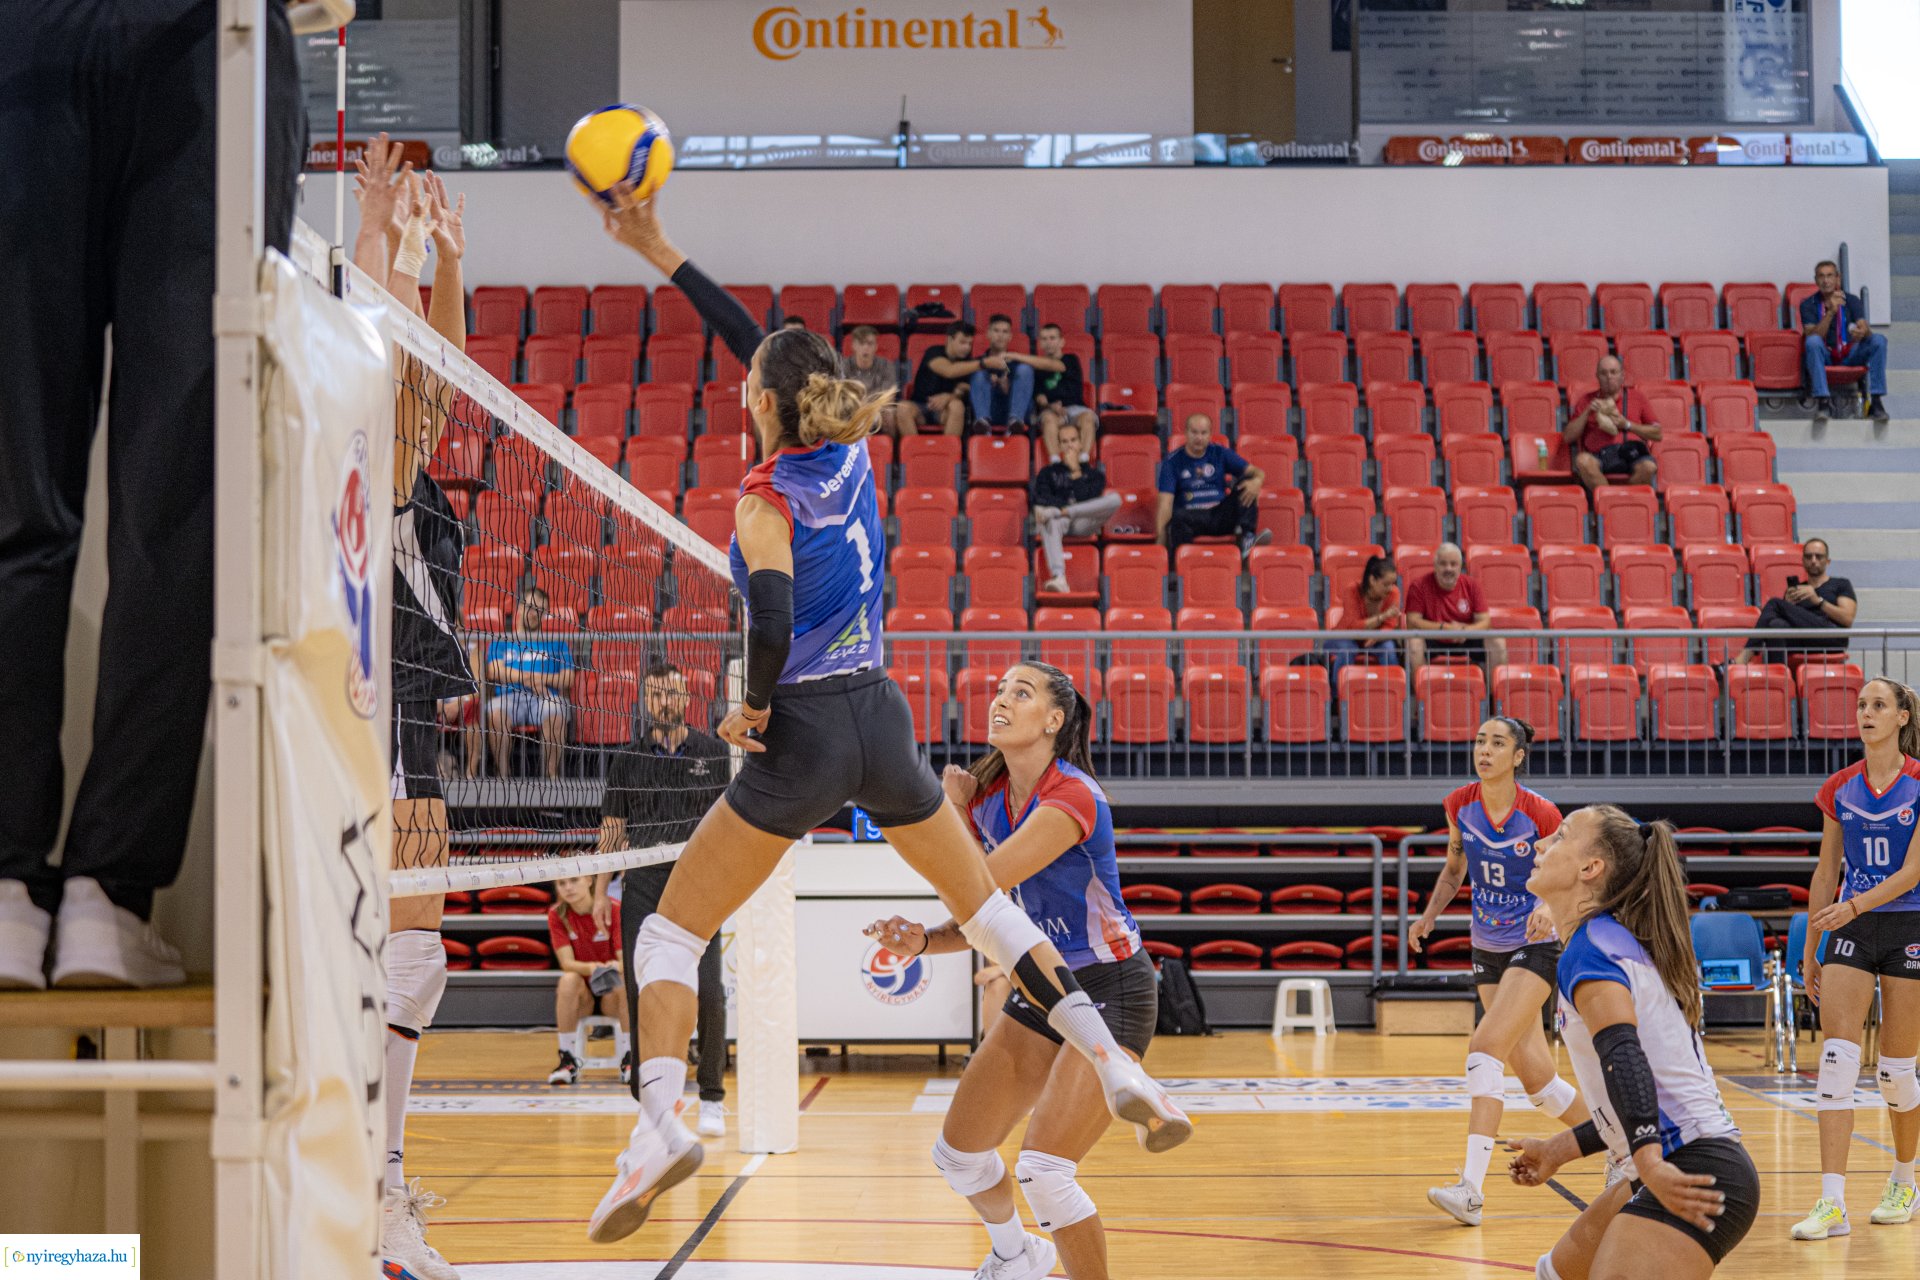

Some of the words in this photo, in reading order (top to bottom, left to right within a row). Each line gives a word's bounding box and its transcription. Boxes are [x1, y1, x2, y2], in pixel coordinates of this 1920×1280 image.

[753, 7, 1021, 61] Continental
[306, 146, 363, 163] inental
[1258, 141, 1349, 161] Continental
[1418, 140, 1513, 161] Continental
[1581, 140, 1676, 162] Continental
[845, 518, 874, 594] 1
[1864, 837, 1890, 867] 10
[1481, 861, 1506, 887] 13
[1834, 938, 1856, 957] 10
